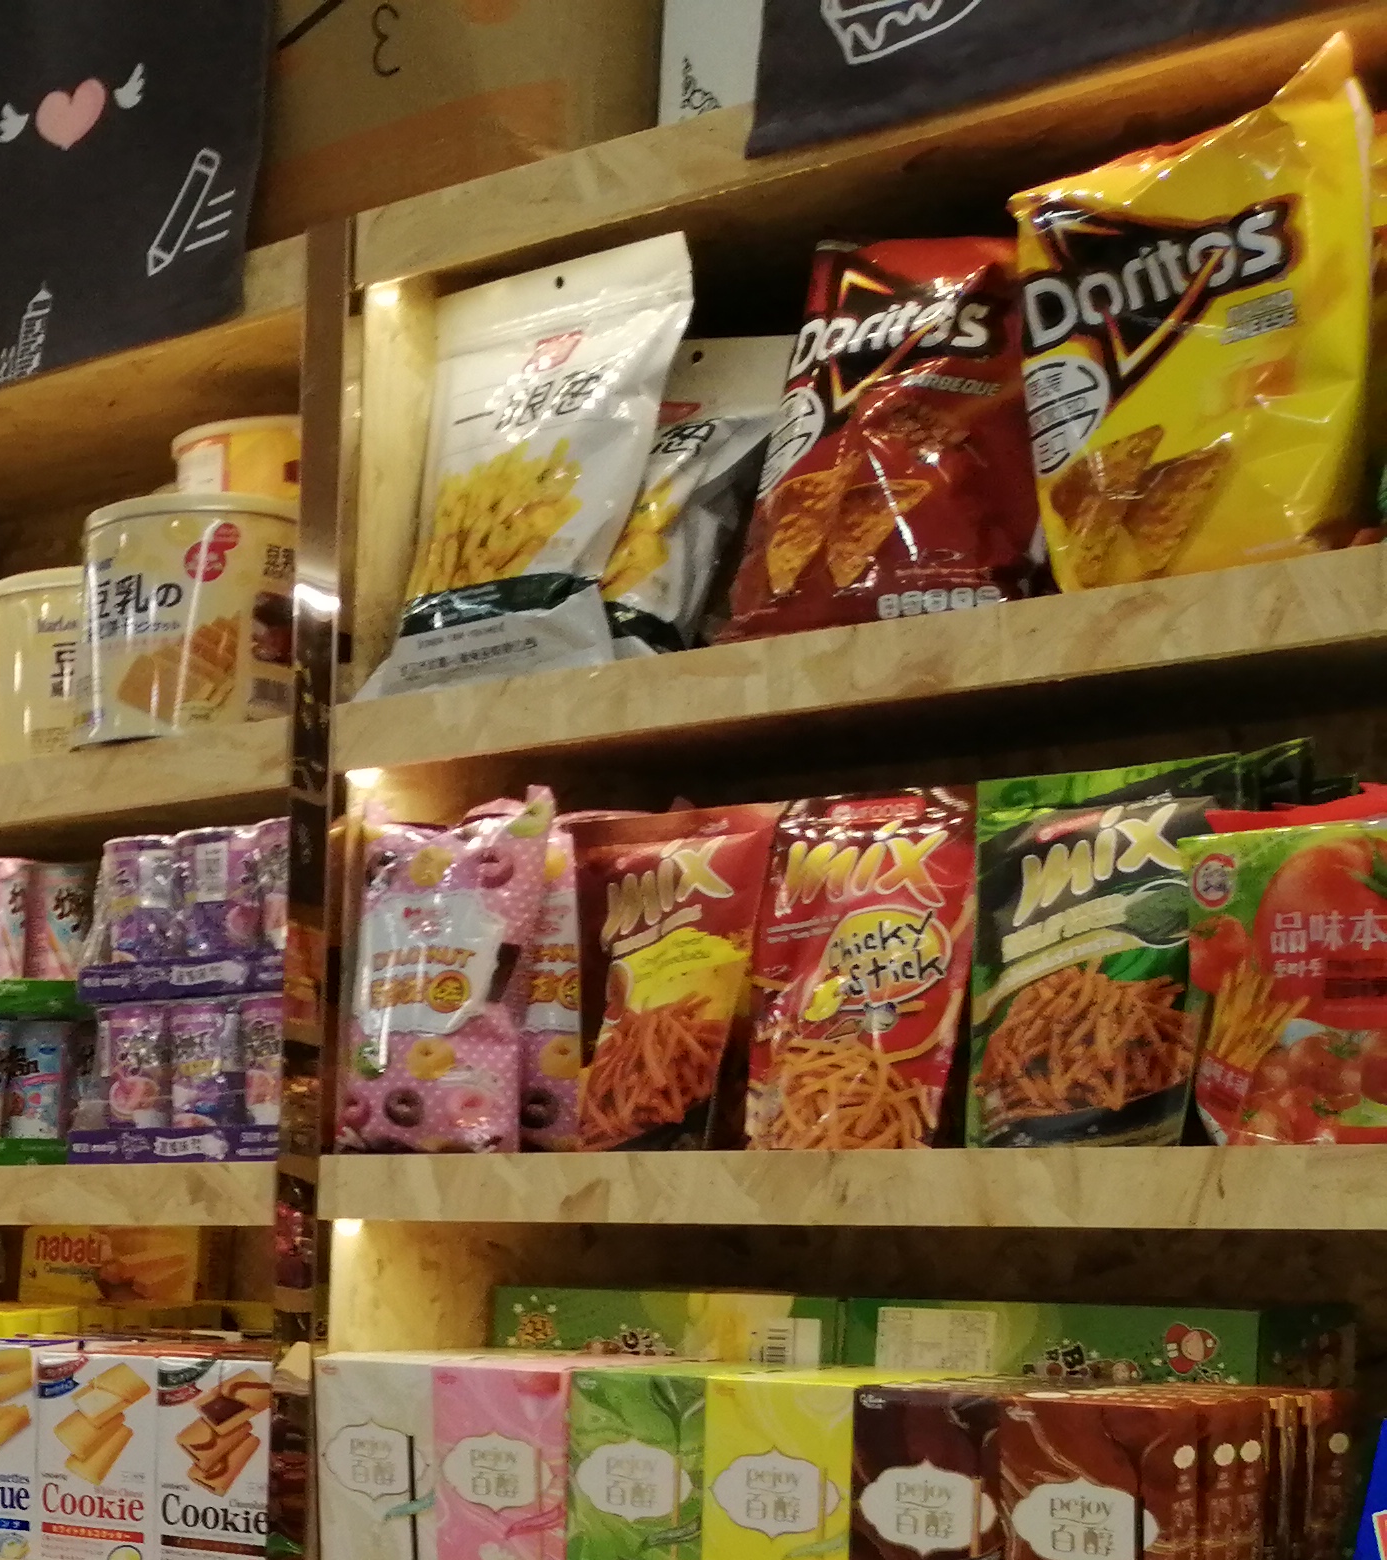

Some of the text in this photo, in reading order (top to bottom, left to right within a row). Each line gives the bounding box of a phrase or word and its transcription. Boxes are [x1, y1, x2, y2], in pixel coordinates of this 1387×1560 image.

[1027, 210, 1282, 347] Doritos
[790, 299, 991, 377] Doritos
[35, 1231, 102, 1265] nabati
[41, 1481, 145, 1522] Cookie
[895, 1478, 957, 1505] pejoy
[161, 1493, 272, 1535] Cookie
[745, 1493, 801, 1524] 百醇
[895, 1508, 955, 1539] 百醇
[1049, 1494, 1116, 1524] pejoy
[1050, 1527, 1116, 1559] 百醇
